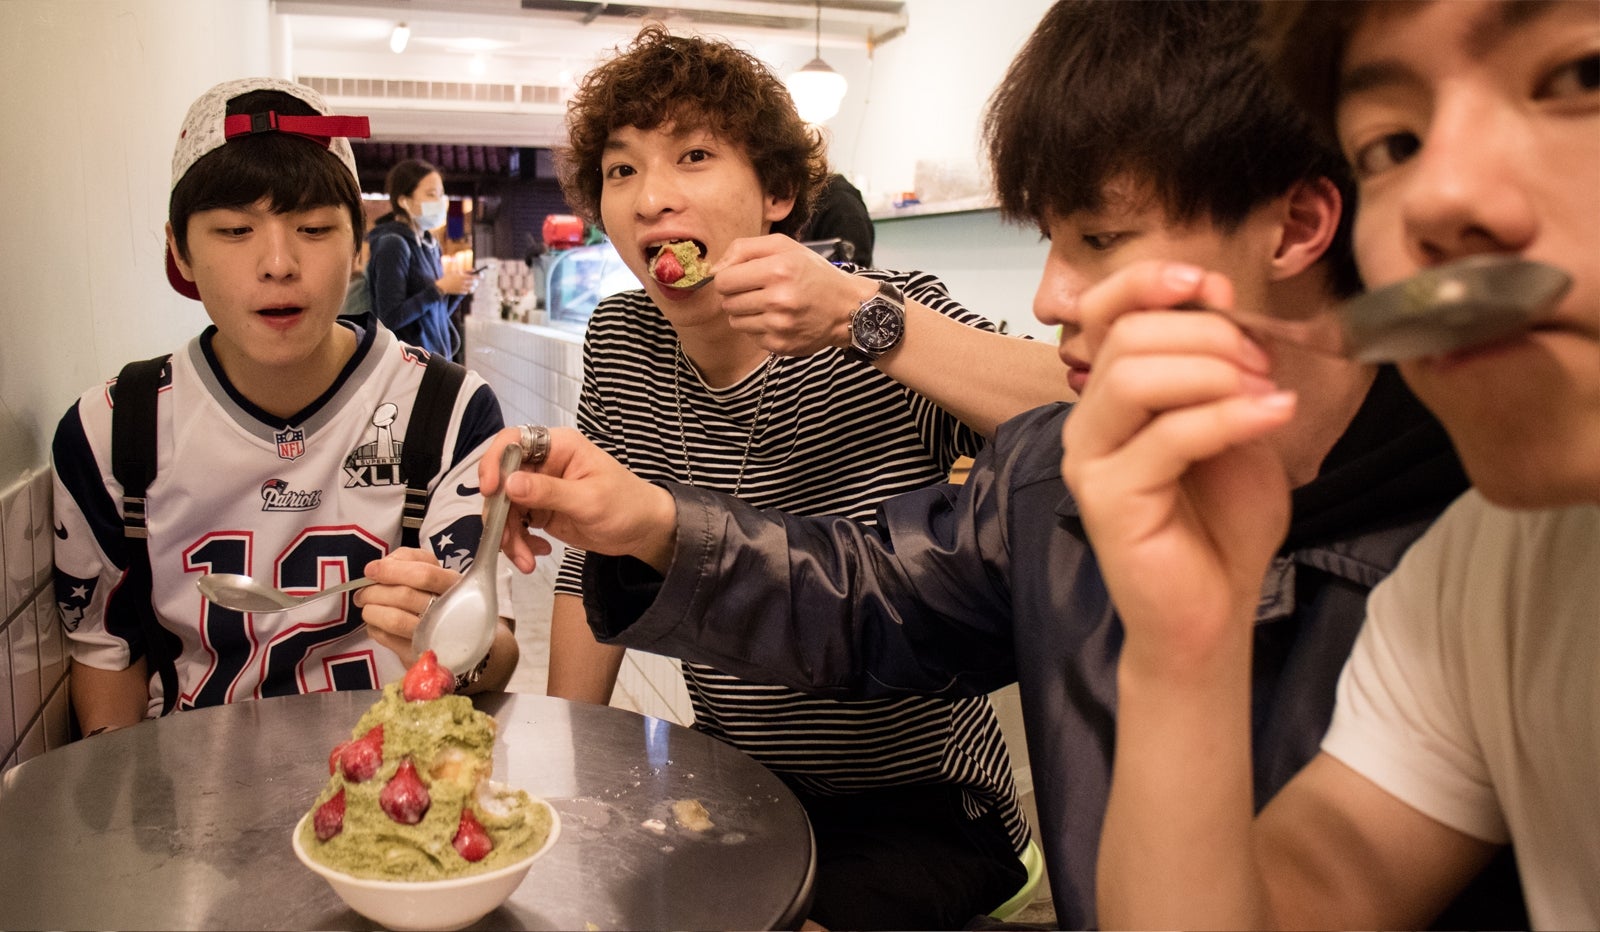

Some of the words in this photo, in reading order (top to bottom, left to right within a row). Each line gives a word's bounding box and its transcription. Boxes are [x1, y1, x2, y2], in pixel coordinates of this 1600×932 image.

[280, 441, 303, 458] NFL
[344, 464, 409, 488] XLI
[261, 485, 322, 511] Patriots
[177, 524, 389, 711] 12
